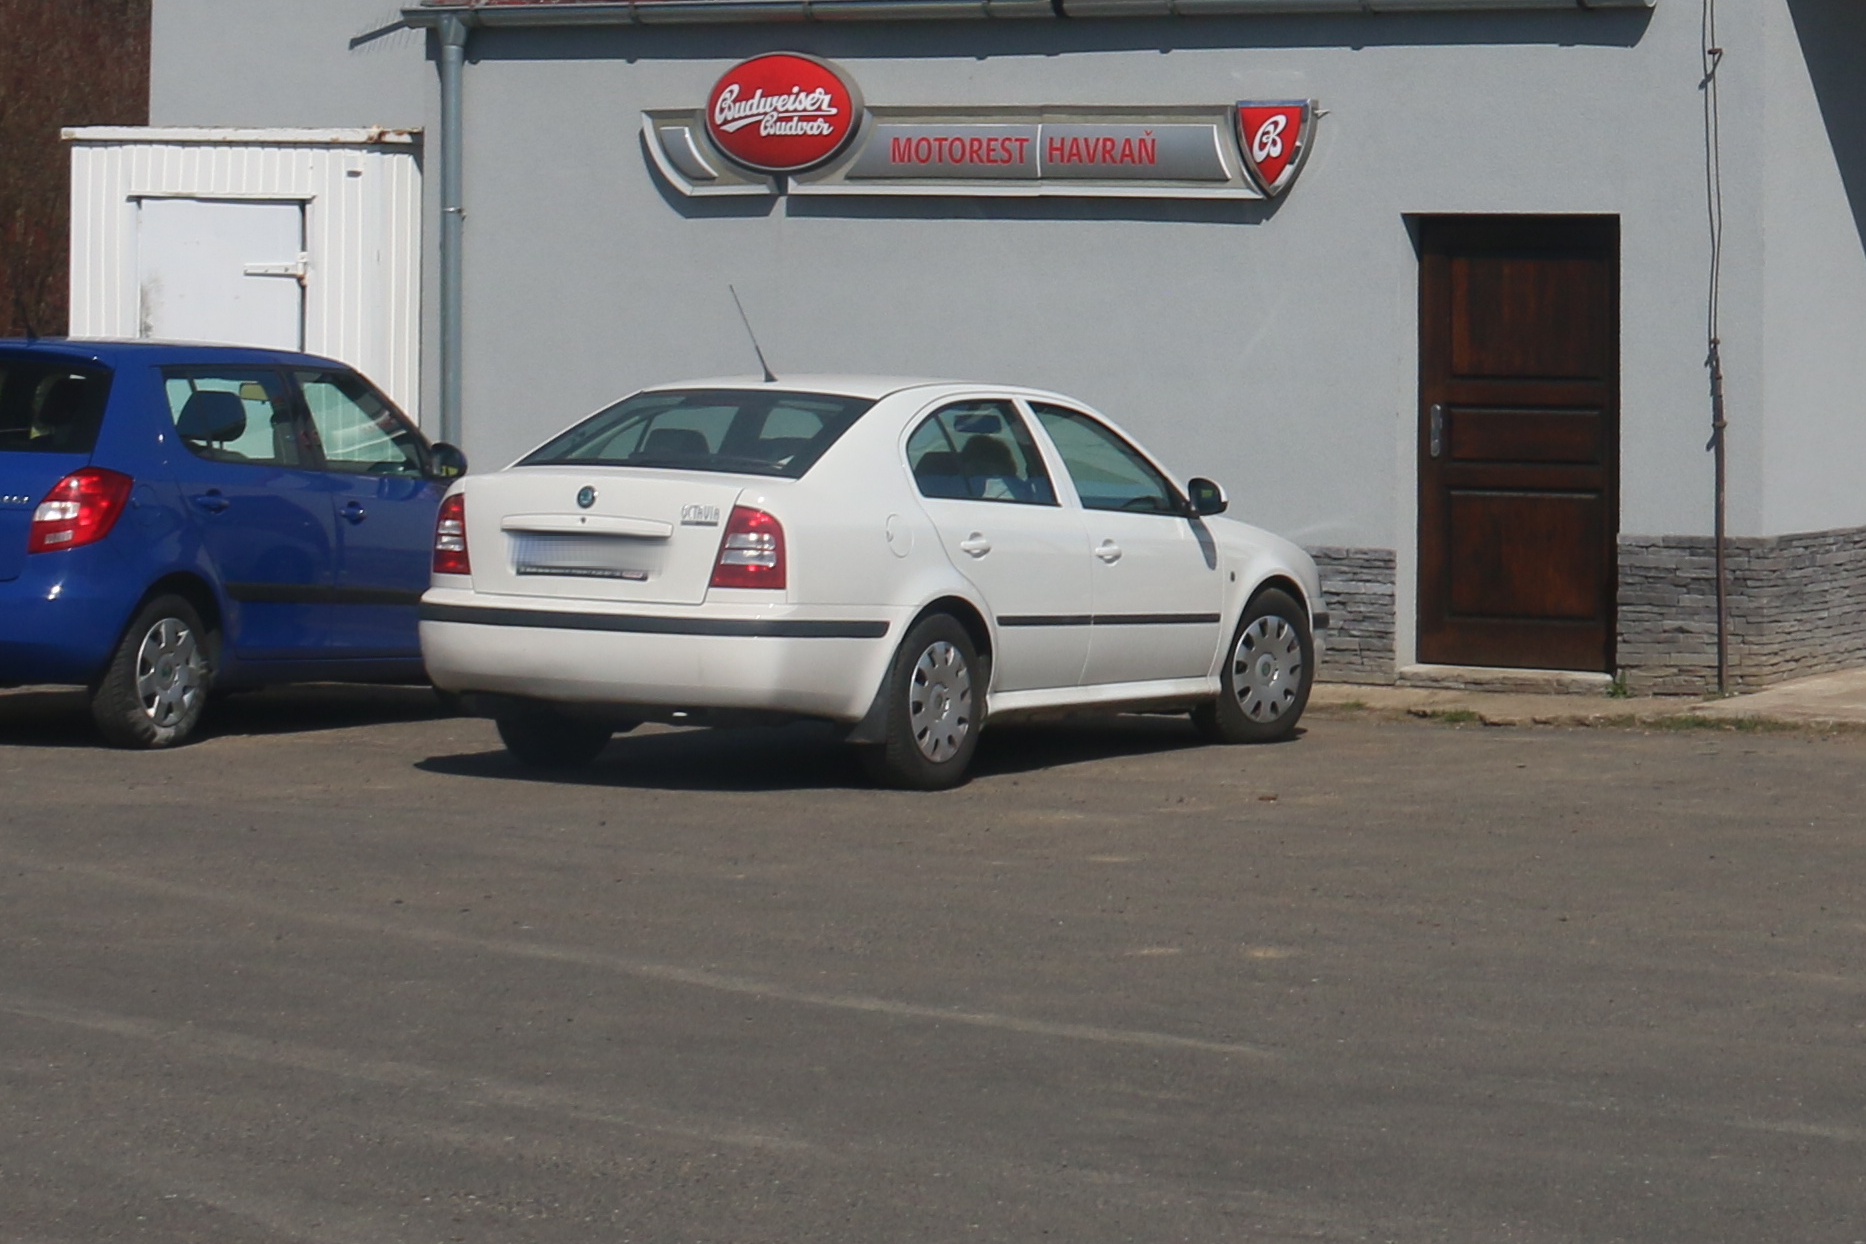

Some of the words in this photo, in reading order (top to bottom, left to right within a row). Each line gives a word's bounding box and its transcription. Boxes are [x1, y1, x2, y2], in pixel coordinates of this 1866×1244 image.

[715, 83, 838, 126] Budweiser
[760, 111, 834, 136] Budvar
[890, 136, 1030, 165] MOTOREST
[1047, 130, 1157, 165] HAVRAŇ
